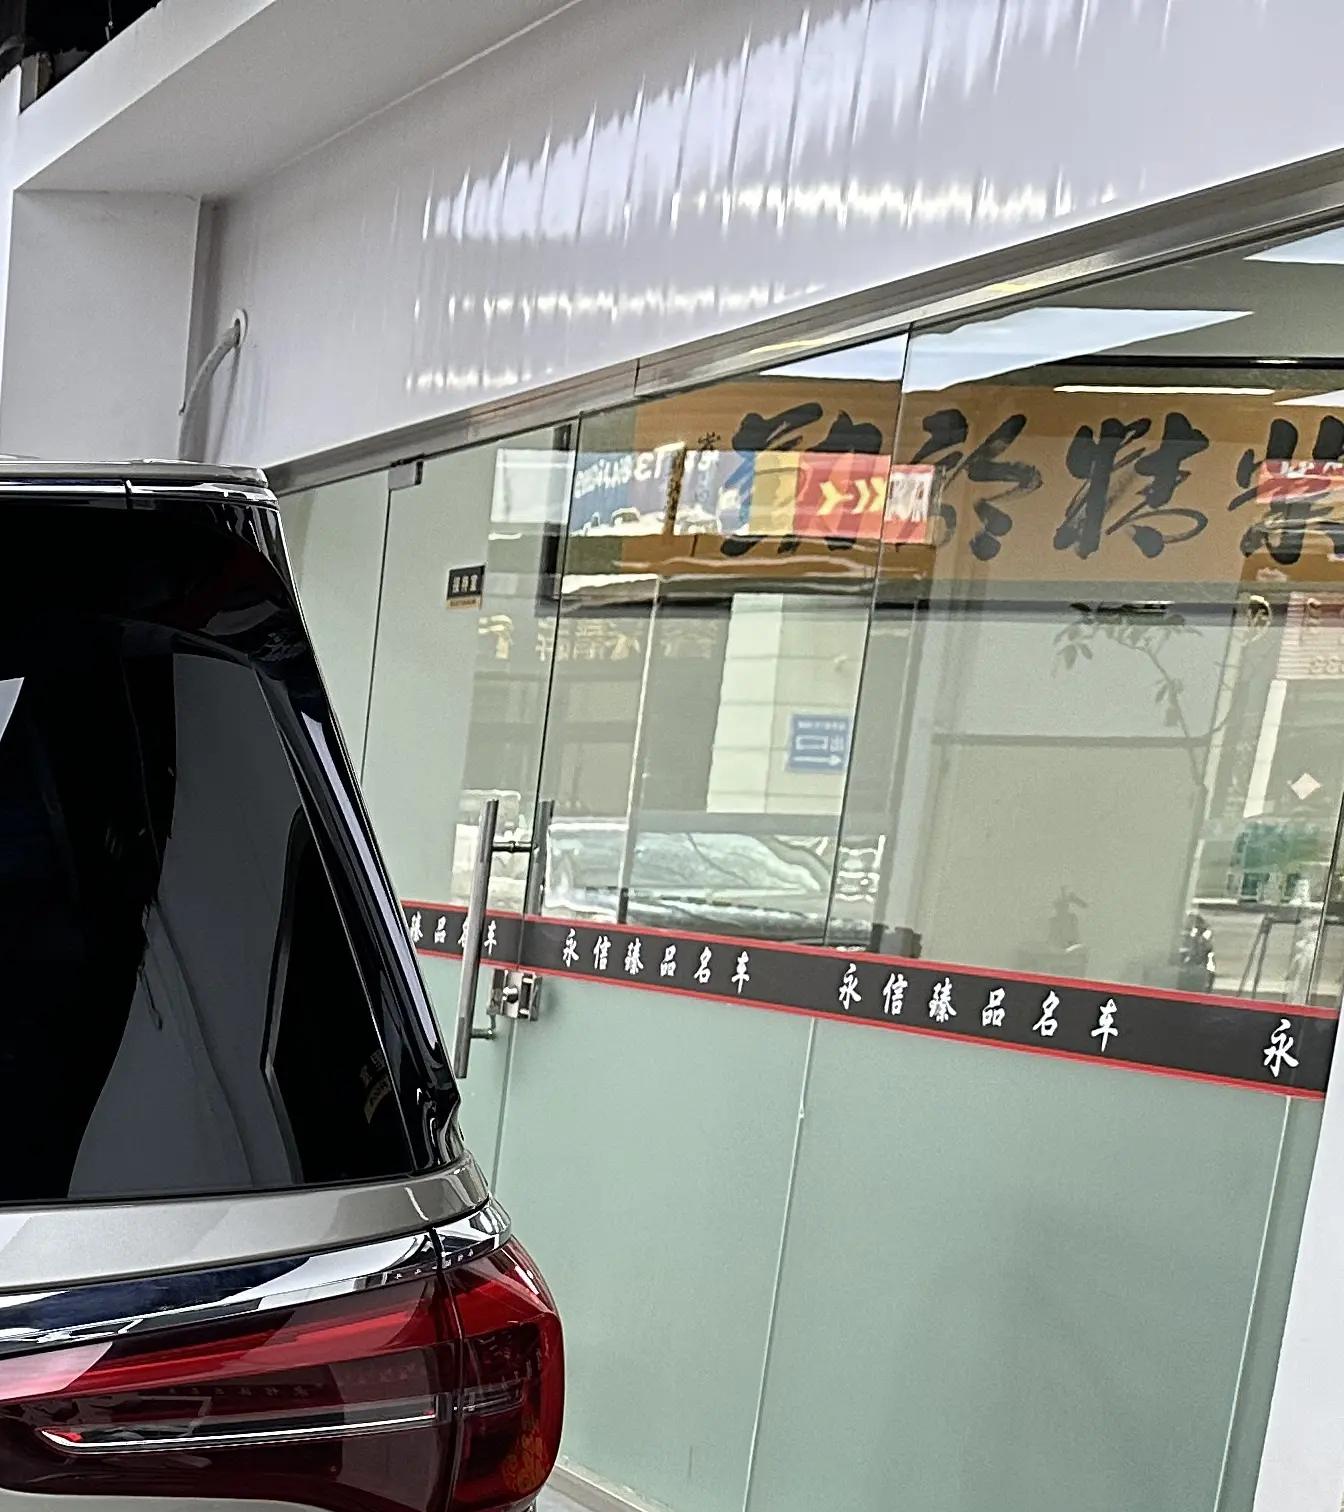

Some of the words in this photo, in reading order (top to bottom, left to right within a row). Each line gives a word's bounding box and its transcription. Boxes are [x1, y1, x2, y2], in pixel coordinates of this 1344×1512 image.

[562, 928, 750, 996] 永信臻品名车
[838, 962, 1120, 1053] 永信臻品名车
[1263, 1018, 1300, 1078] 永
